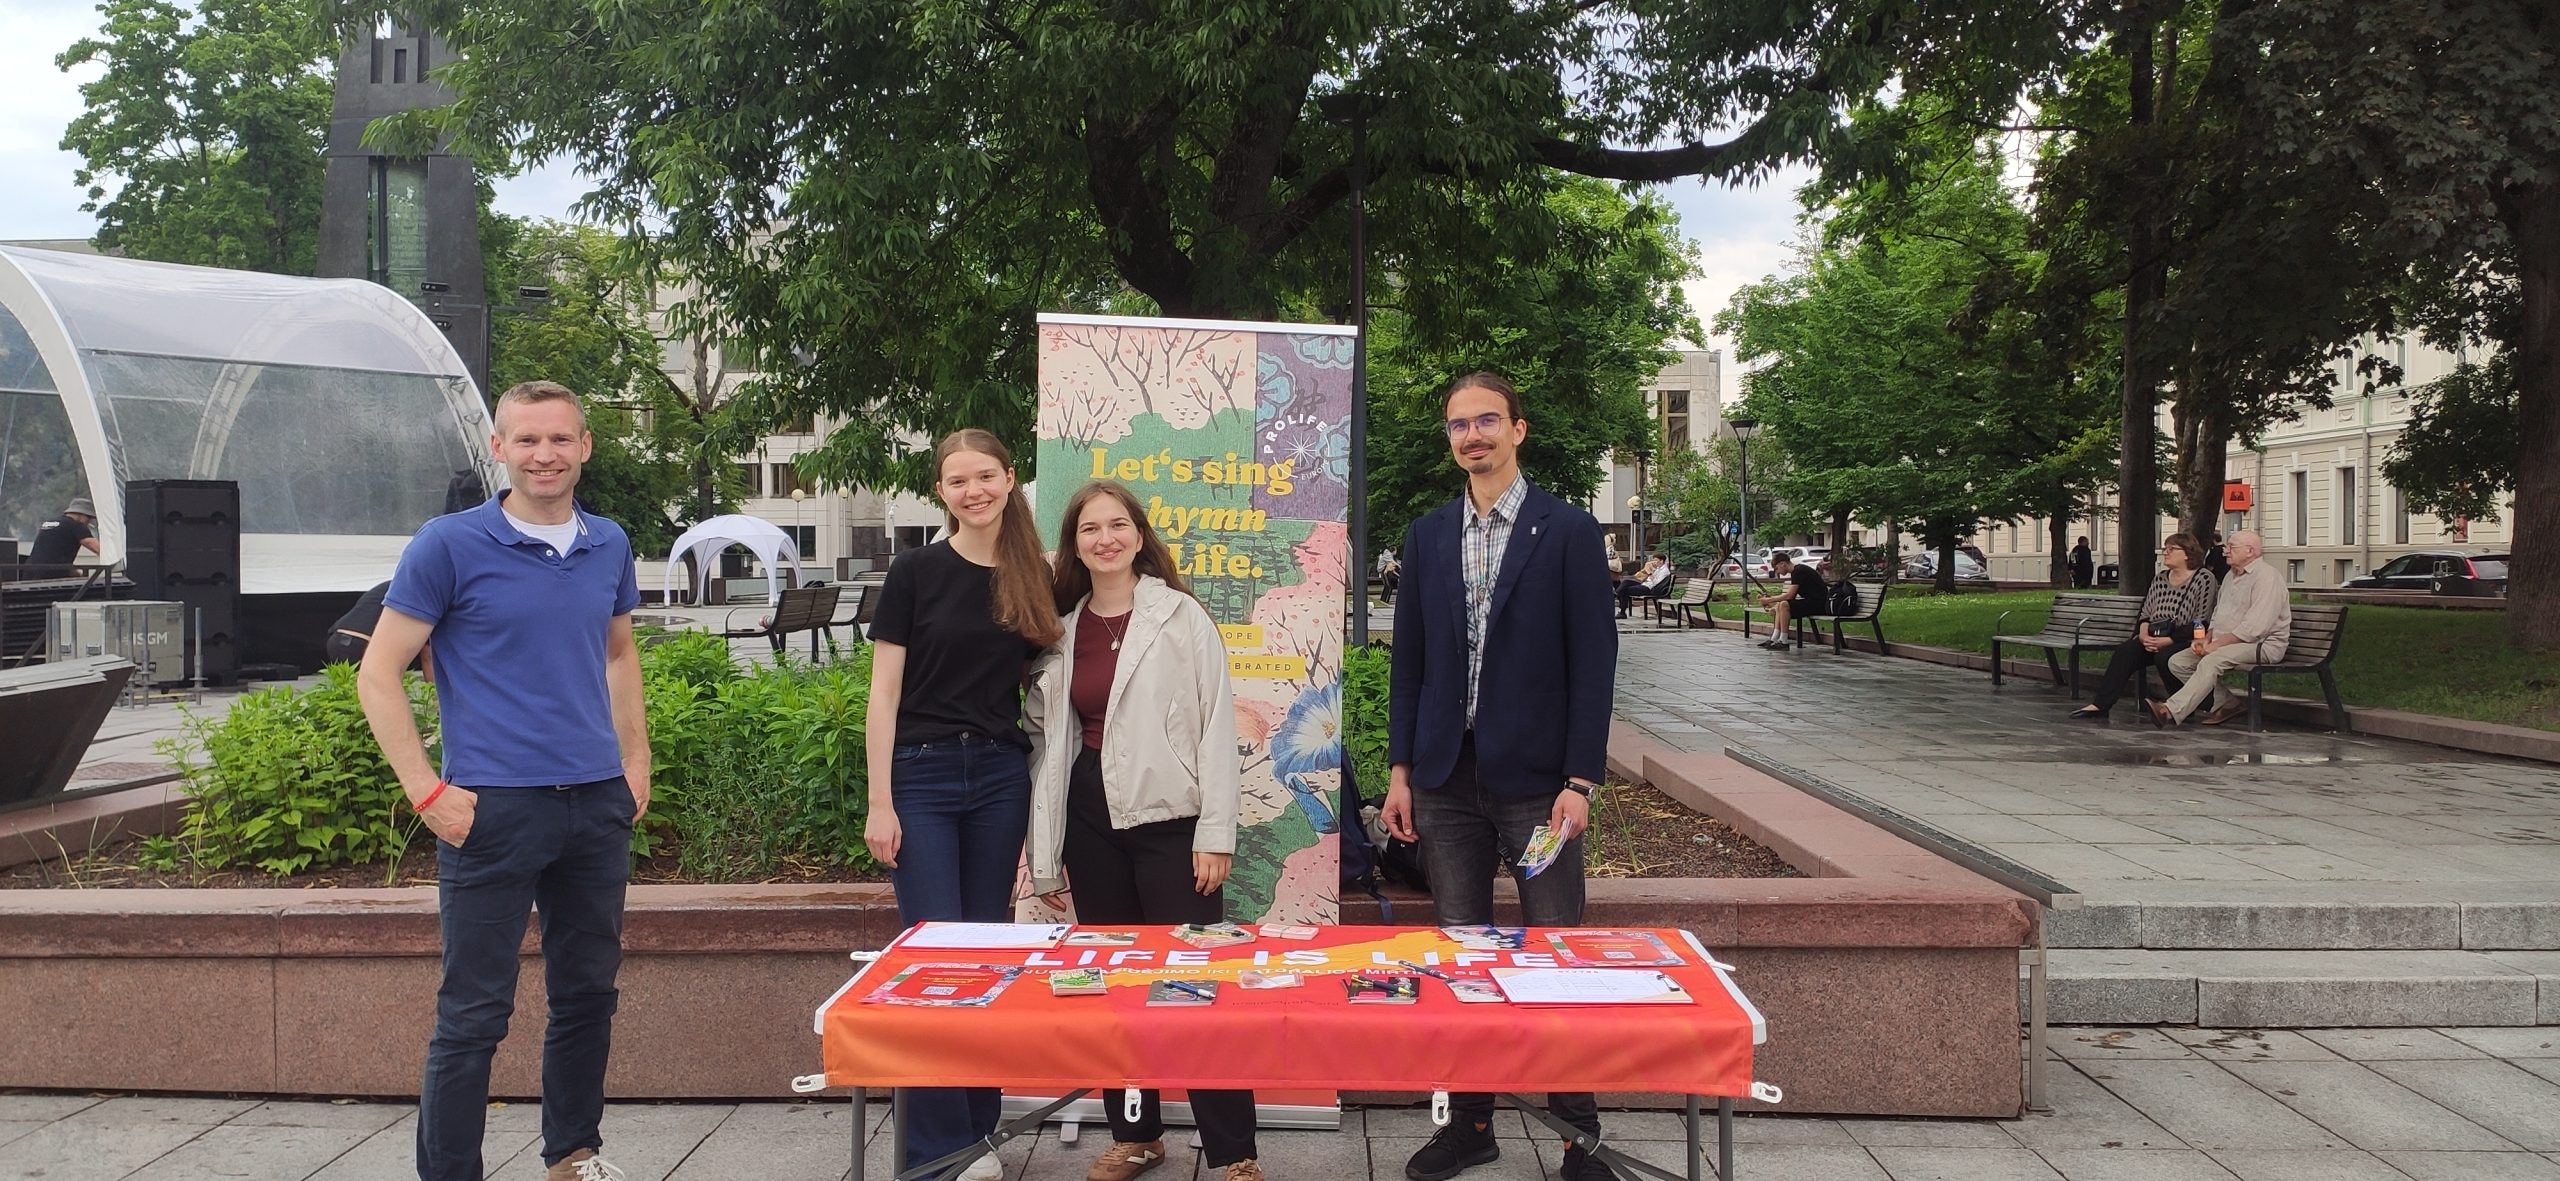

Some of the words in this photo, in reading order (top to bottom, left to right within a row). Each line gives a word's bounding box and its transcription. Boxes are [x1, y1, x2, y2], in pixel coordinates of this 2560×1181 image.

[1263, 413, 1328, 454] PROLIFE
[1203, 452, 1296, 496] sing
[1147, 496, 1266, 538] hymn
[1167, 543, 1263, 578] Life.
[1221, 632, 1253, 640] OPE
[1024, 950, 1212, 966] LIFE
[1253, 950, 1330, 966] IS
[1372, 951, 1559, 967] LIFE
